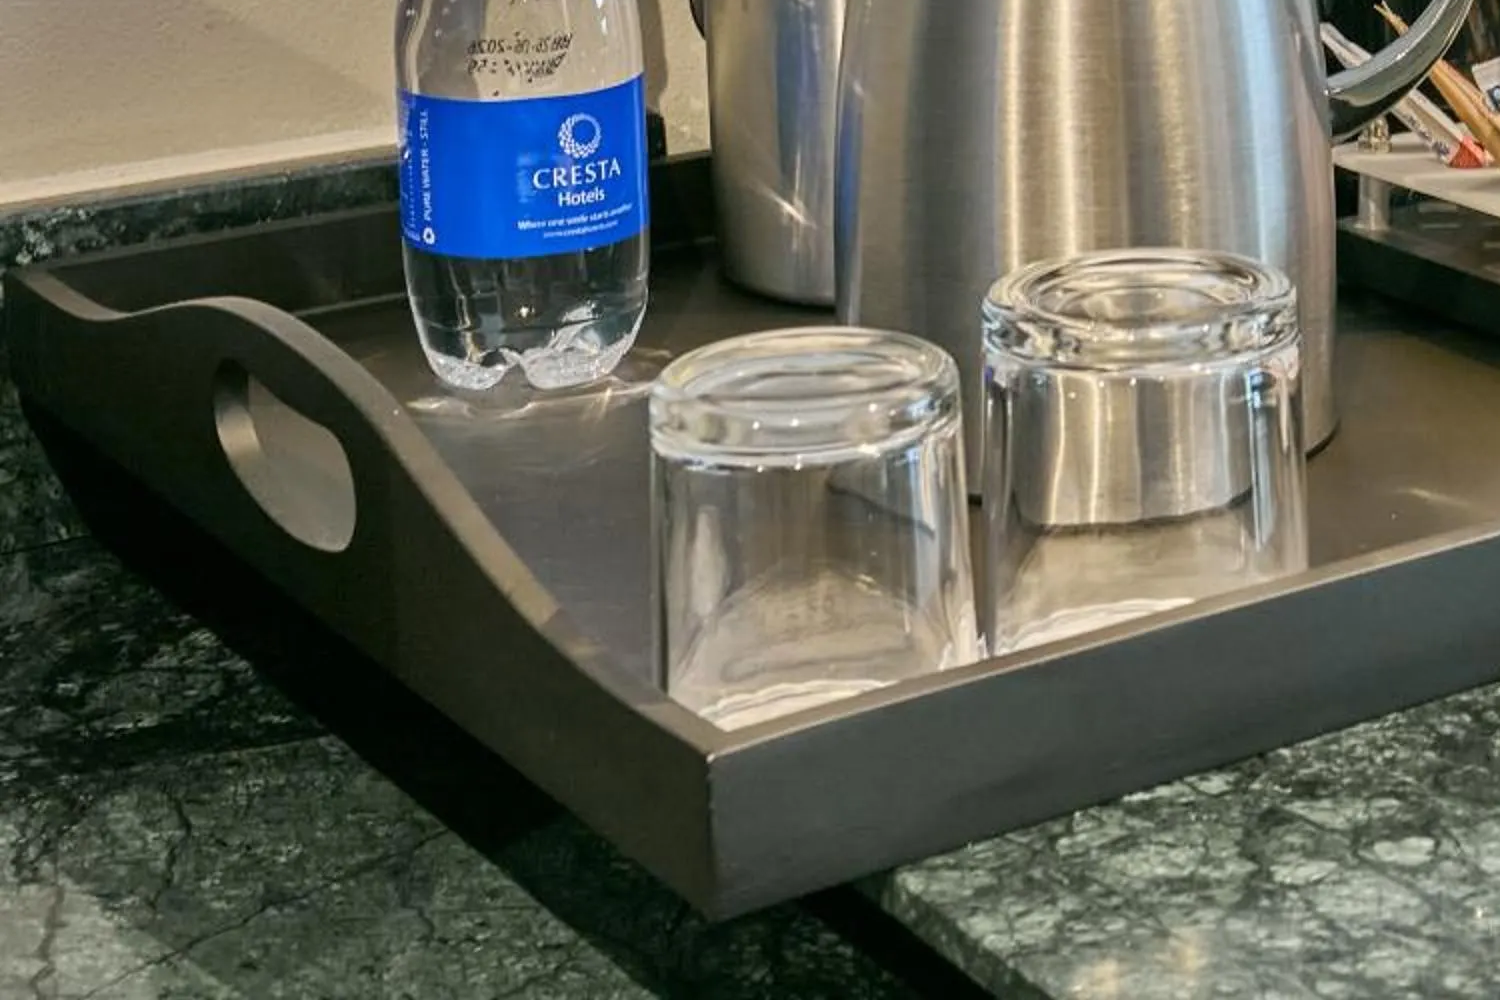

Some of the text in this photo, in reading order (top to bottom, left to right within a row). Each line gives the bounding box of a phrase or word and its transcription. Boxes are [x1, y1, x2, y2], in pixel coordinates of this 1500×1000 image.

[421, 148, 432, 189] WATER
[532, 157, 622, 190] CRESTA
[422, 191, 433, 222] PURE
[558, 187, 605, 208] Hotels
